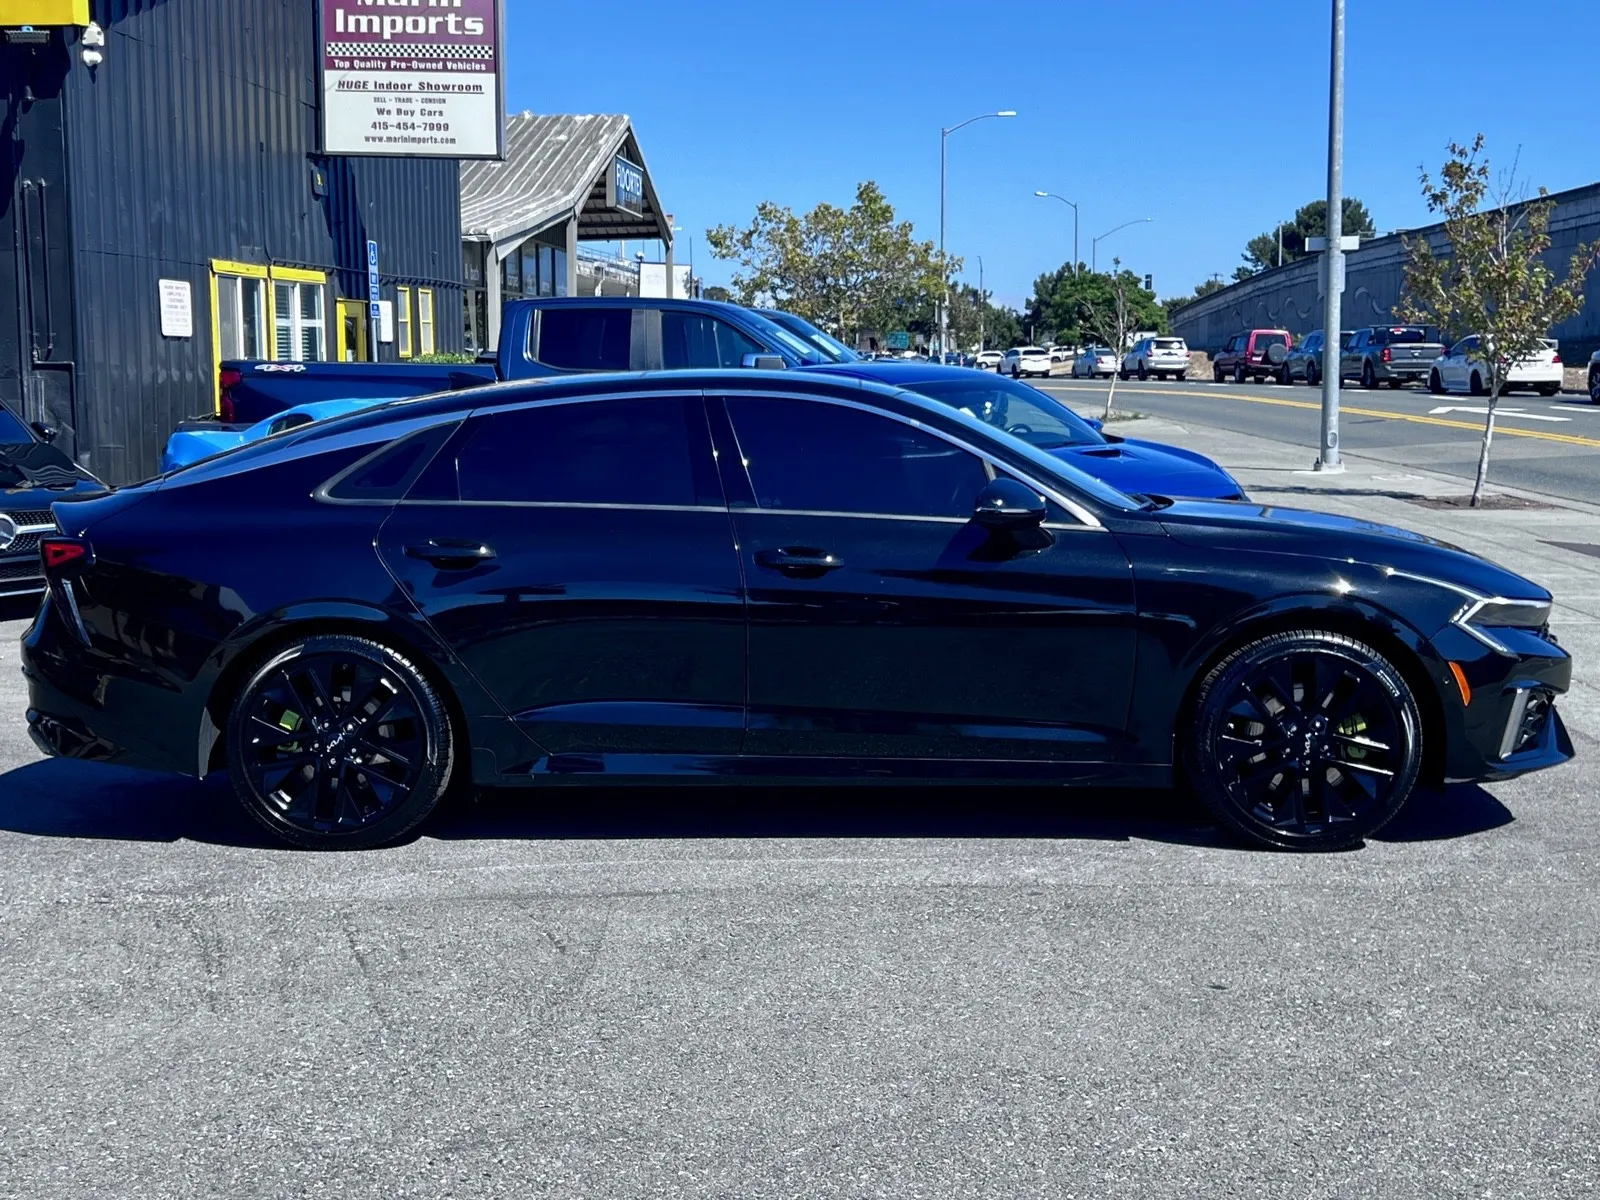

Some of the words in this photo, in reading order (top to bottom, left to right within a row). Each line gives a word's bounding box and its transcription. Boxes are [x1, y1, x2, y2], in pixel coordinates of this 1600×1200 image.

[335, 8, 484, 40] Imports
[333, 59, 350, 69] Top
[353, 60, 387, 70] Quality
[390, 60, 443, 70] Pre-Owned
[446, 61, 487, 71] Vehicles
[337, 80, 369, 90] HUGE
[374, 81, 413, 90] Indoor
[418, 81, 483, 92] Showroom
[376, 107, 392, 116] We
[396, 108, 415, 117] Buy
[420, 108, 444, 117] Cars
[370, 121, 450, 131] 415-454-7999
[364, 135, 456, 144] www.marinimports.com
